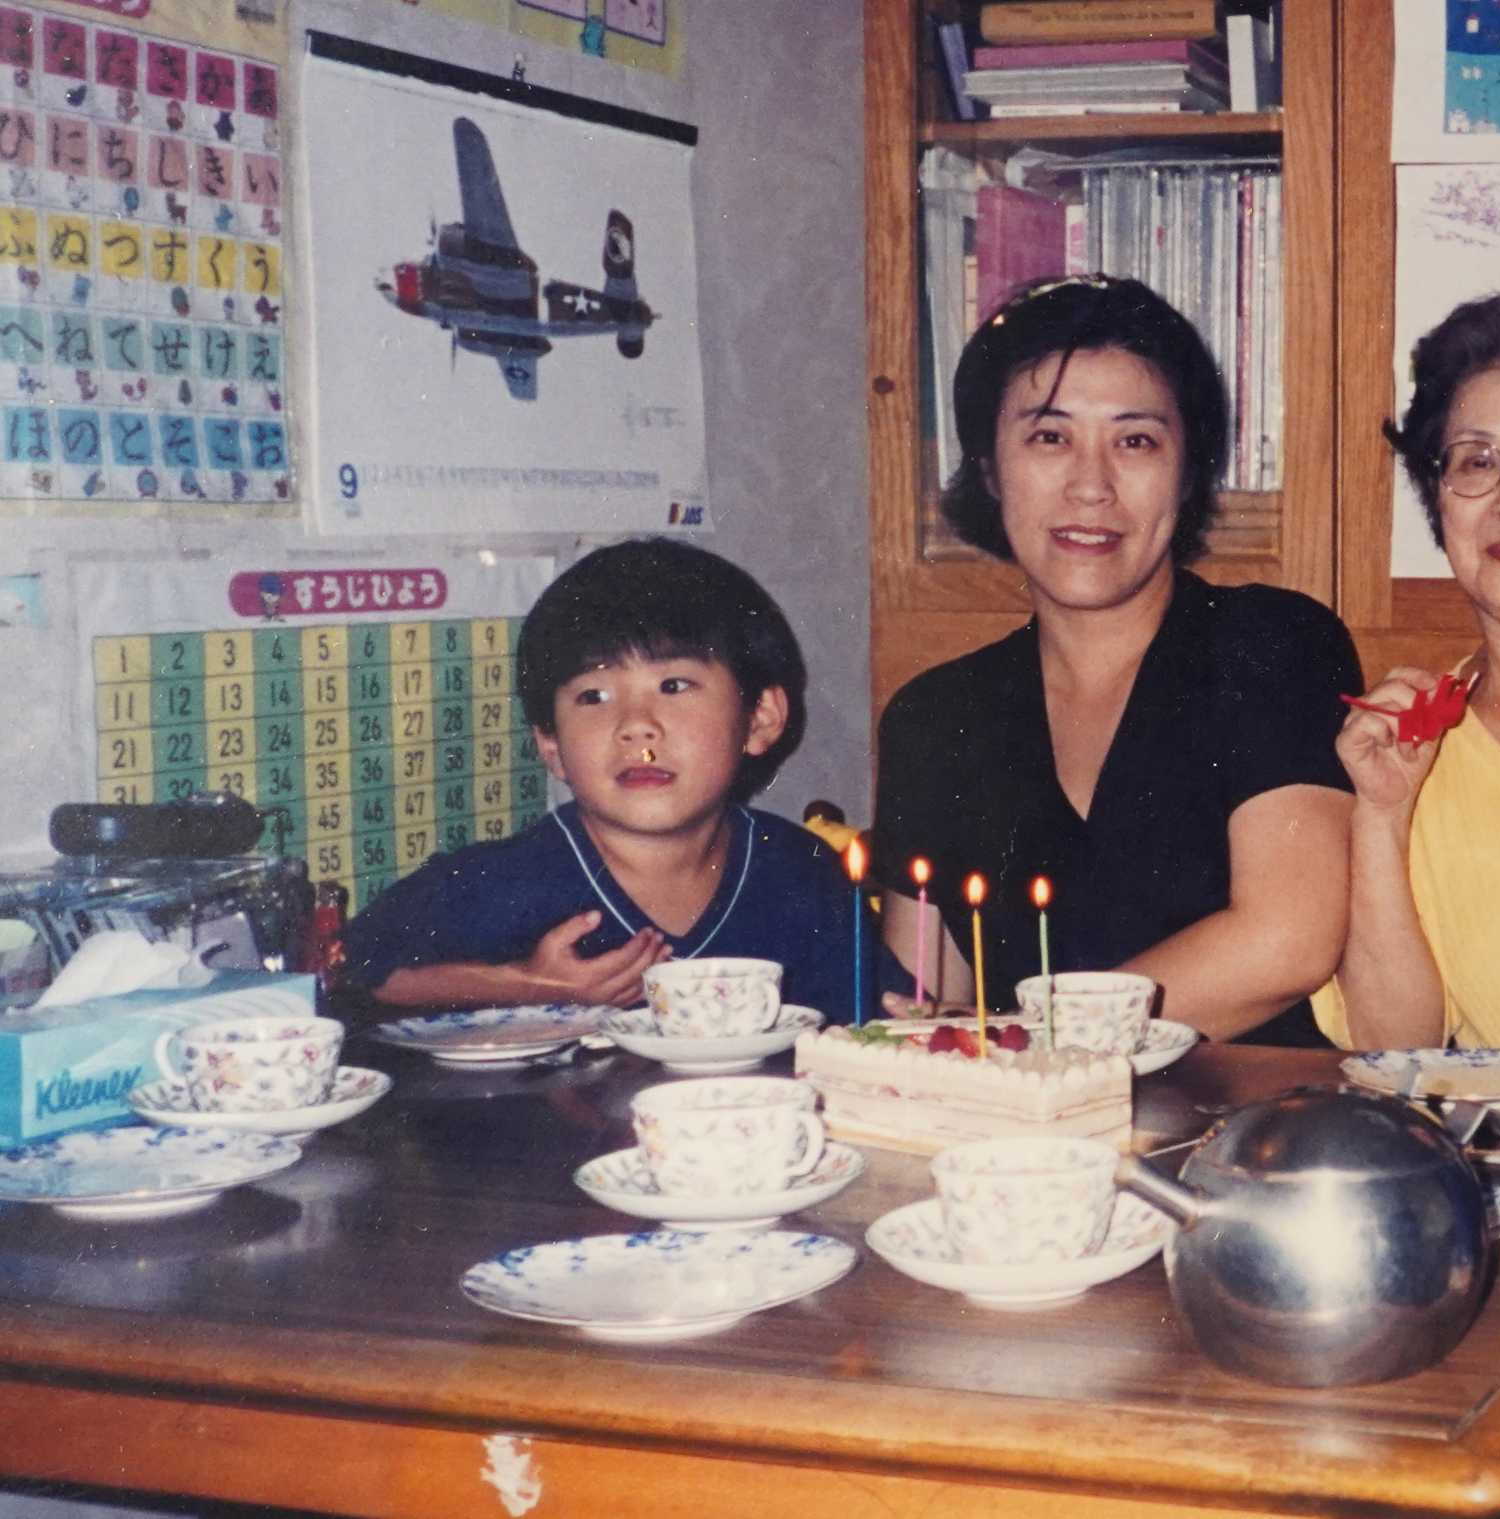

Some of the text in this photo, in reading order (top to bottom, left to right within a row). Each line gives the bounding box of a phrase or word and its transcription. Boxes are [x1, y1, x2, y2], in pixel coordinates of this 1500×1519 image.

[52, 122, 84, 165] に
[104, 130, 134, 178] ち
[158, 140, 181, 188] し
[203, 146, 226, 196] き
[246, 163, 280, 194] い
[0, 212, 270, 292] ふ ぬ つ す く う
[0, 316, 277, 381] へ ね て せ け え
[9, 410, 283, 468] ほ の と そ こ お
[338, 463, 360, 499] 9
[293, 574, 441, 608] すうじひょう
[120, 626, 495, 673] 1 2 3 4 5 6 7 8 9
[113, 664, 501, 721] 11 12 13 14 15 16 17 18 19
[112, 738, 136, 768] 21
[167, 732, 193, 762] 22
[219, 728, 244, 757] 23
[268, 723, 292, 752] 24
[315, 718, 338, 746] 25
[360, 715, 382, 742] 26
[403, 711, 424, 737] 27
[443, 706, 464, 733] 28
[482, 703, 501, 728] 29
[269, 767, 293, 795] 34
[316, 761, 339, 789] 35
[360, 757, 383, 783] 36
[404, 751, 425, 777] 37
[444, 746, 465, 772] 38
[483, 743, 502, 768] 39
[317, 805, 341, 830] 45
[363, 798, 384, 824] 46
[405, 791, 425, 816] 47
[445, 784, 465, 811] 48
[484, 780, 501, 804] 49
[520, 774, 538, 800] 50
[319, 846, 341, 873] 55
[363, 840, 385, 866] 56
[406, 831, 427, 858] 57
[447, 825, 467, 850] 58
[35, 1066, 143, 1120] Kleenex
